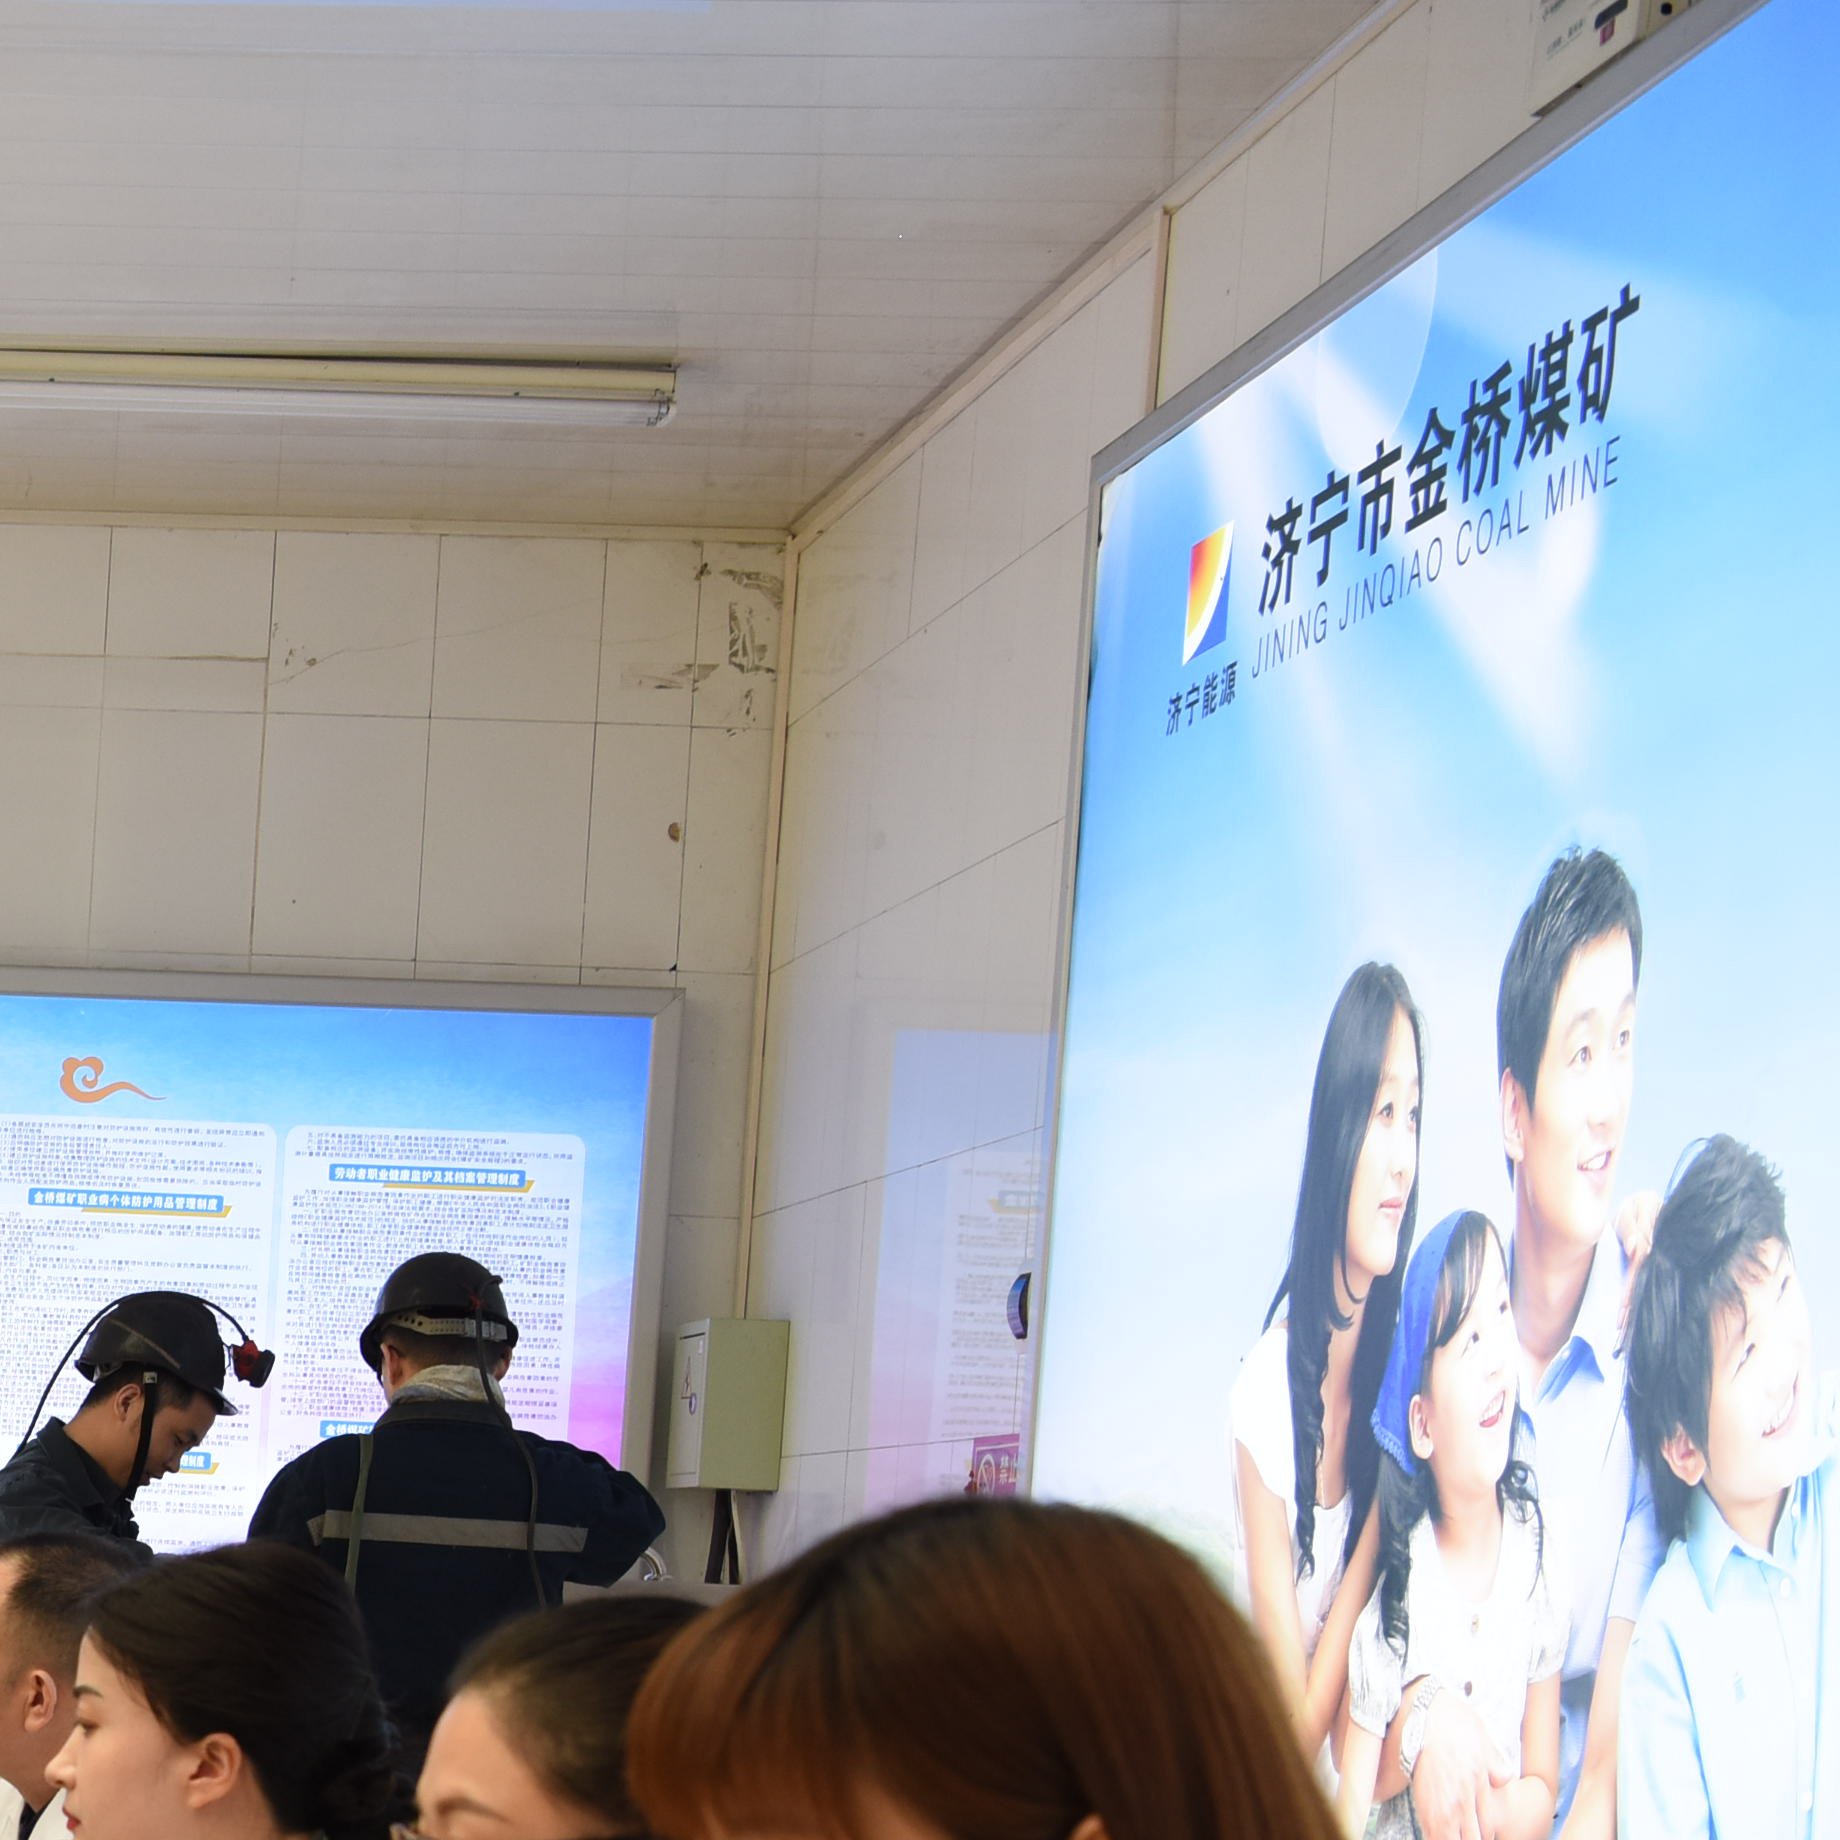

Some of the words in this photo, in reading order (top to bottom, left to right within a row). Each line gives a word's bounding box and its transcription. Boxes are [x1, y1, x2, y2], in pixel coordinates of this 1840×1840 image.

[1252, 601, 1328, 678] JINING
[1339, 537, 1443, 631] JINQIAO
[1456, 490, 1529, 566] COAL
[1545, 435, 1620, 520] MINE
[1258, 282, 1640, 616] 济宁市金桥煤矿
[1165, 661, 1238, 736] 济宁能源
